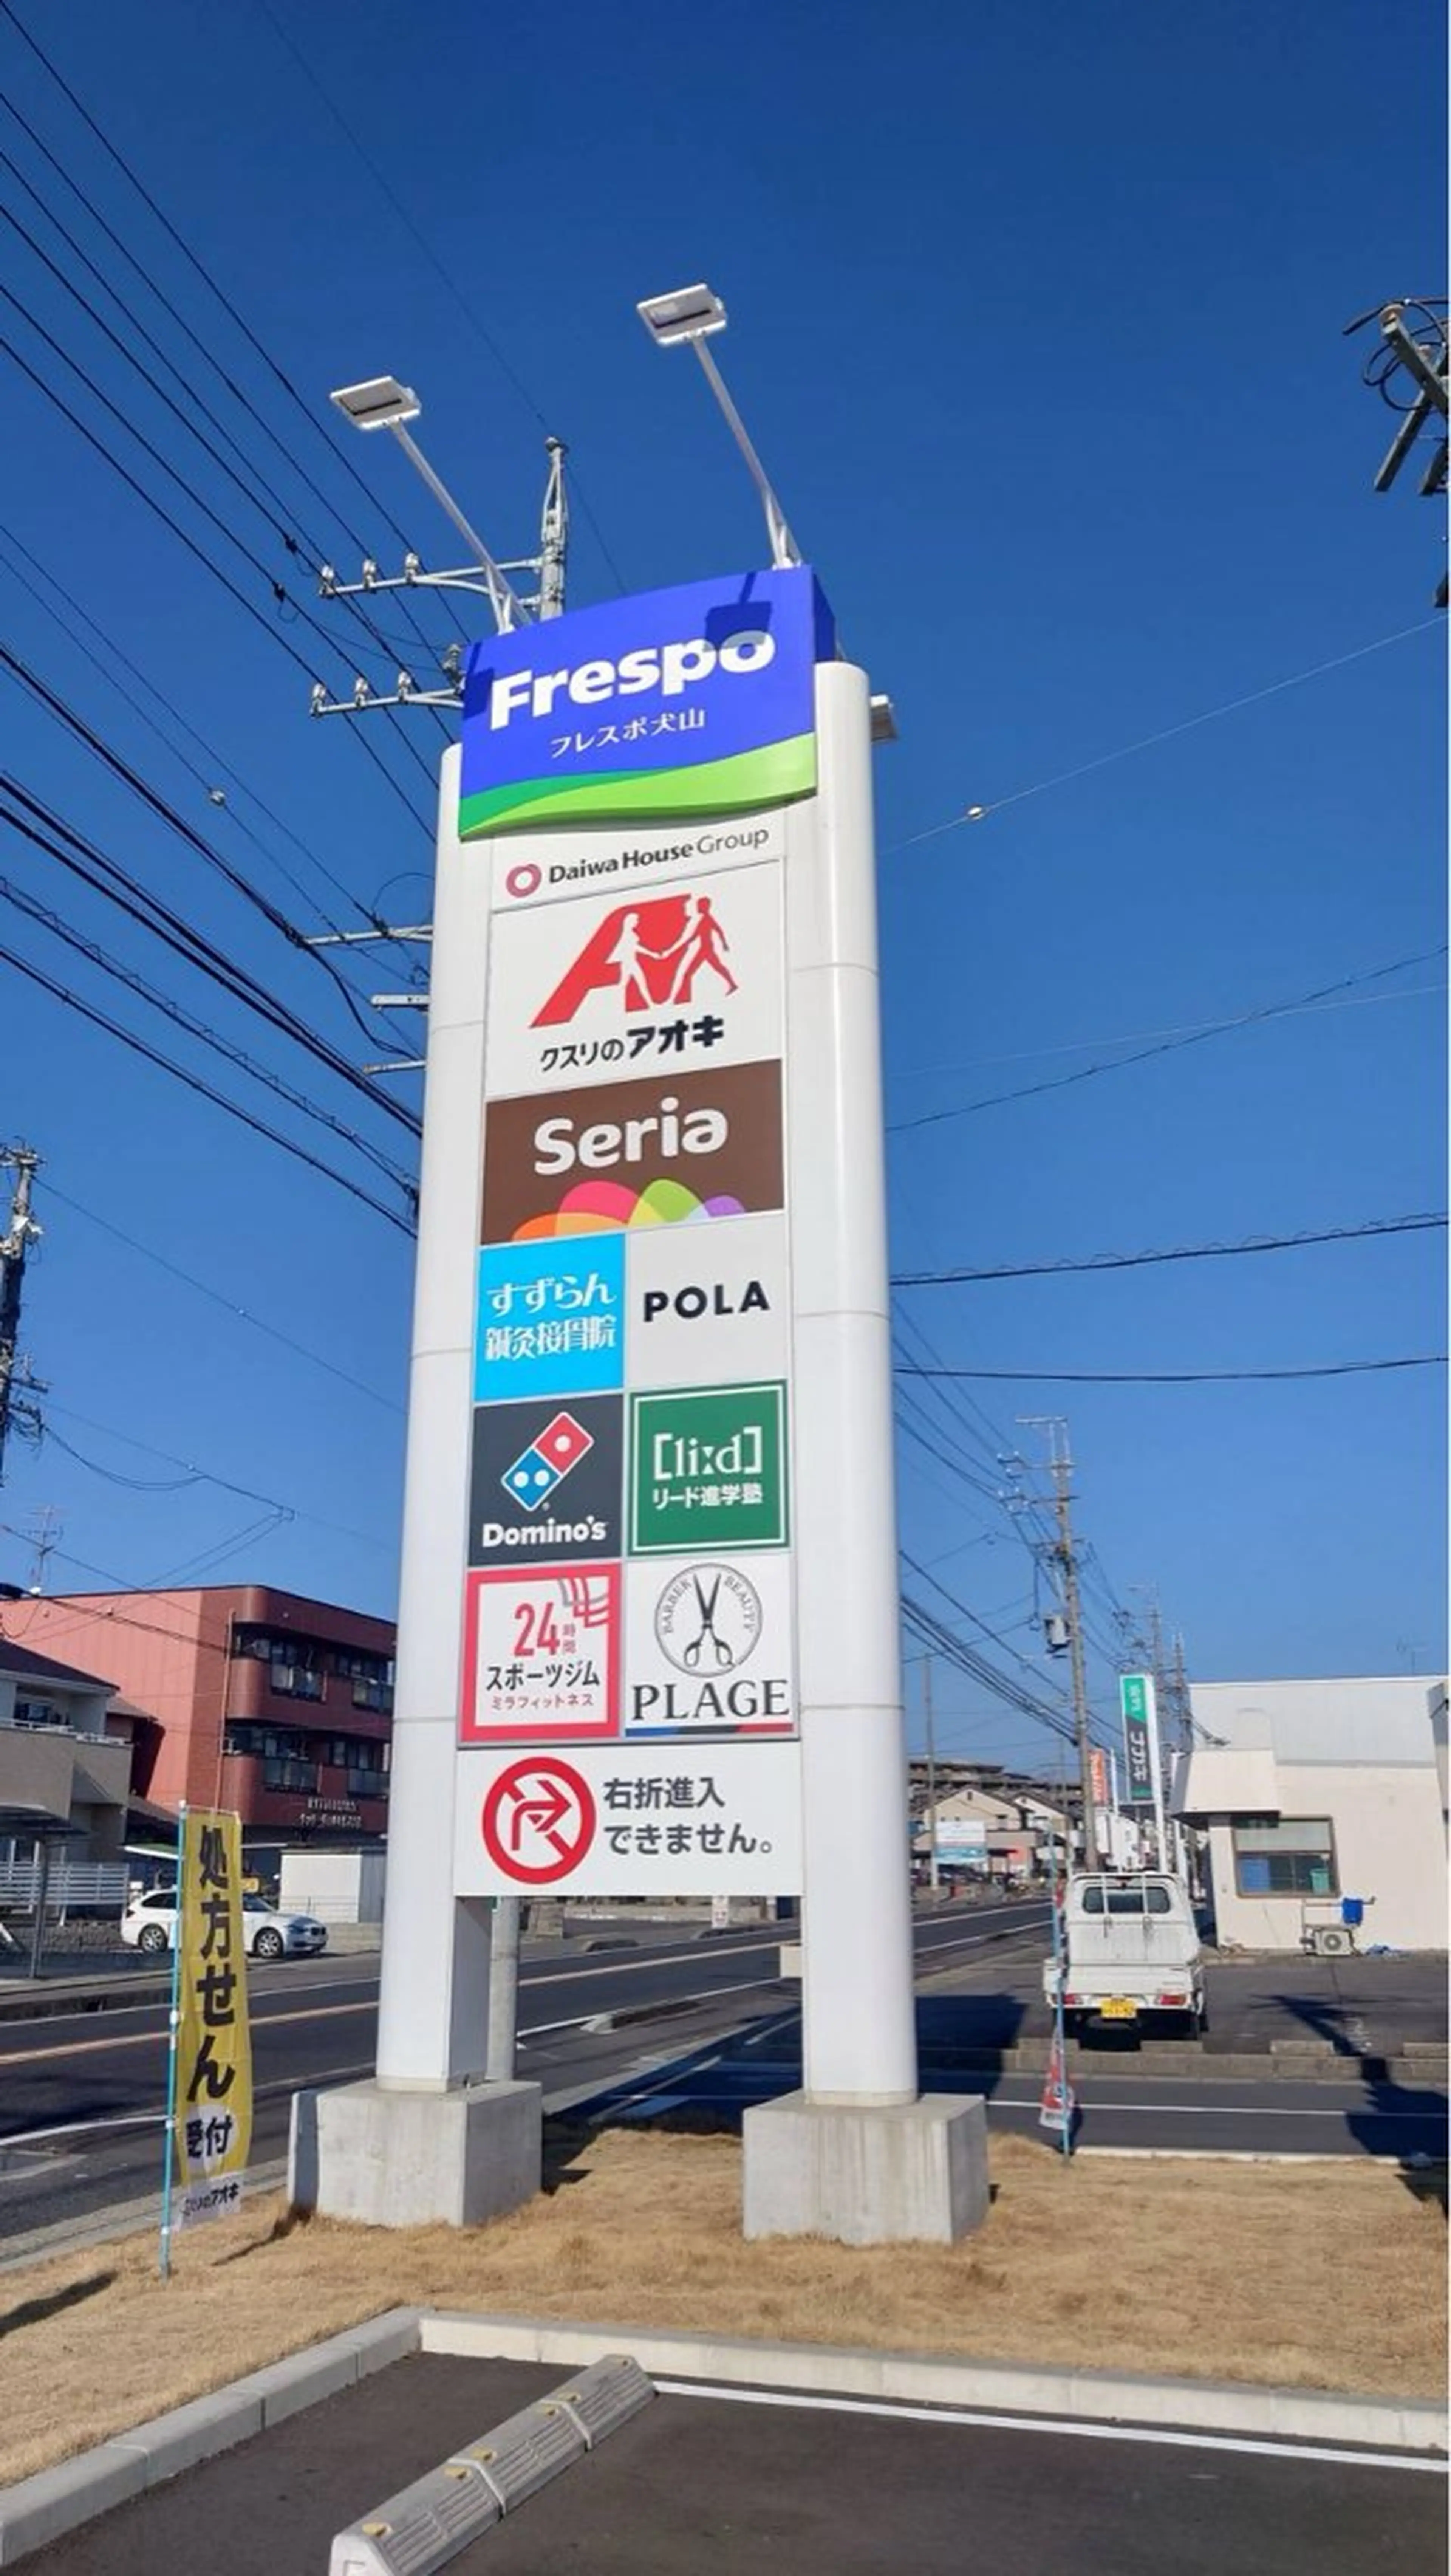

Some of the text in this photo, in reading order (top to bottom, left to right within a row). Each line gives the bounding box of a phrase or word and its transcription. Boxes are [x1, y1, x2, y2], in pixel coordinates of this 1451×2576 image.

[490, 630, 776, 730] Frespo
[551, 708, 705, 758] フレスポ犬山
[549, 828, 769, 884] Daiwa House Group
[540, 1014, 724, 1072] クスリのアオキ
[534, 1097, 729, 1176] Seria
[487, 1273, 617, 1318] すずらん
[644, 1280, 770, 1322] POLA
[653, 1482, 763, 1510] リード進学塾
[482, 1515, 607, 1548] Domino's
[486, 1660, 600, 1691] スポーツジム
[632, 1680, 790, 1721] PLAGE
[605, 1777, 726, 1810] 右折進入
[605, 1824, 773, 1855] できません。
[186, 1825, 237, 2103] 処方せん
